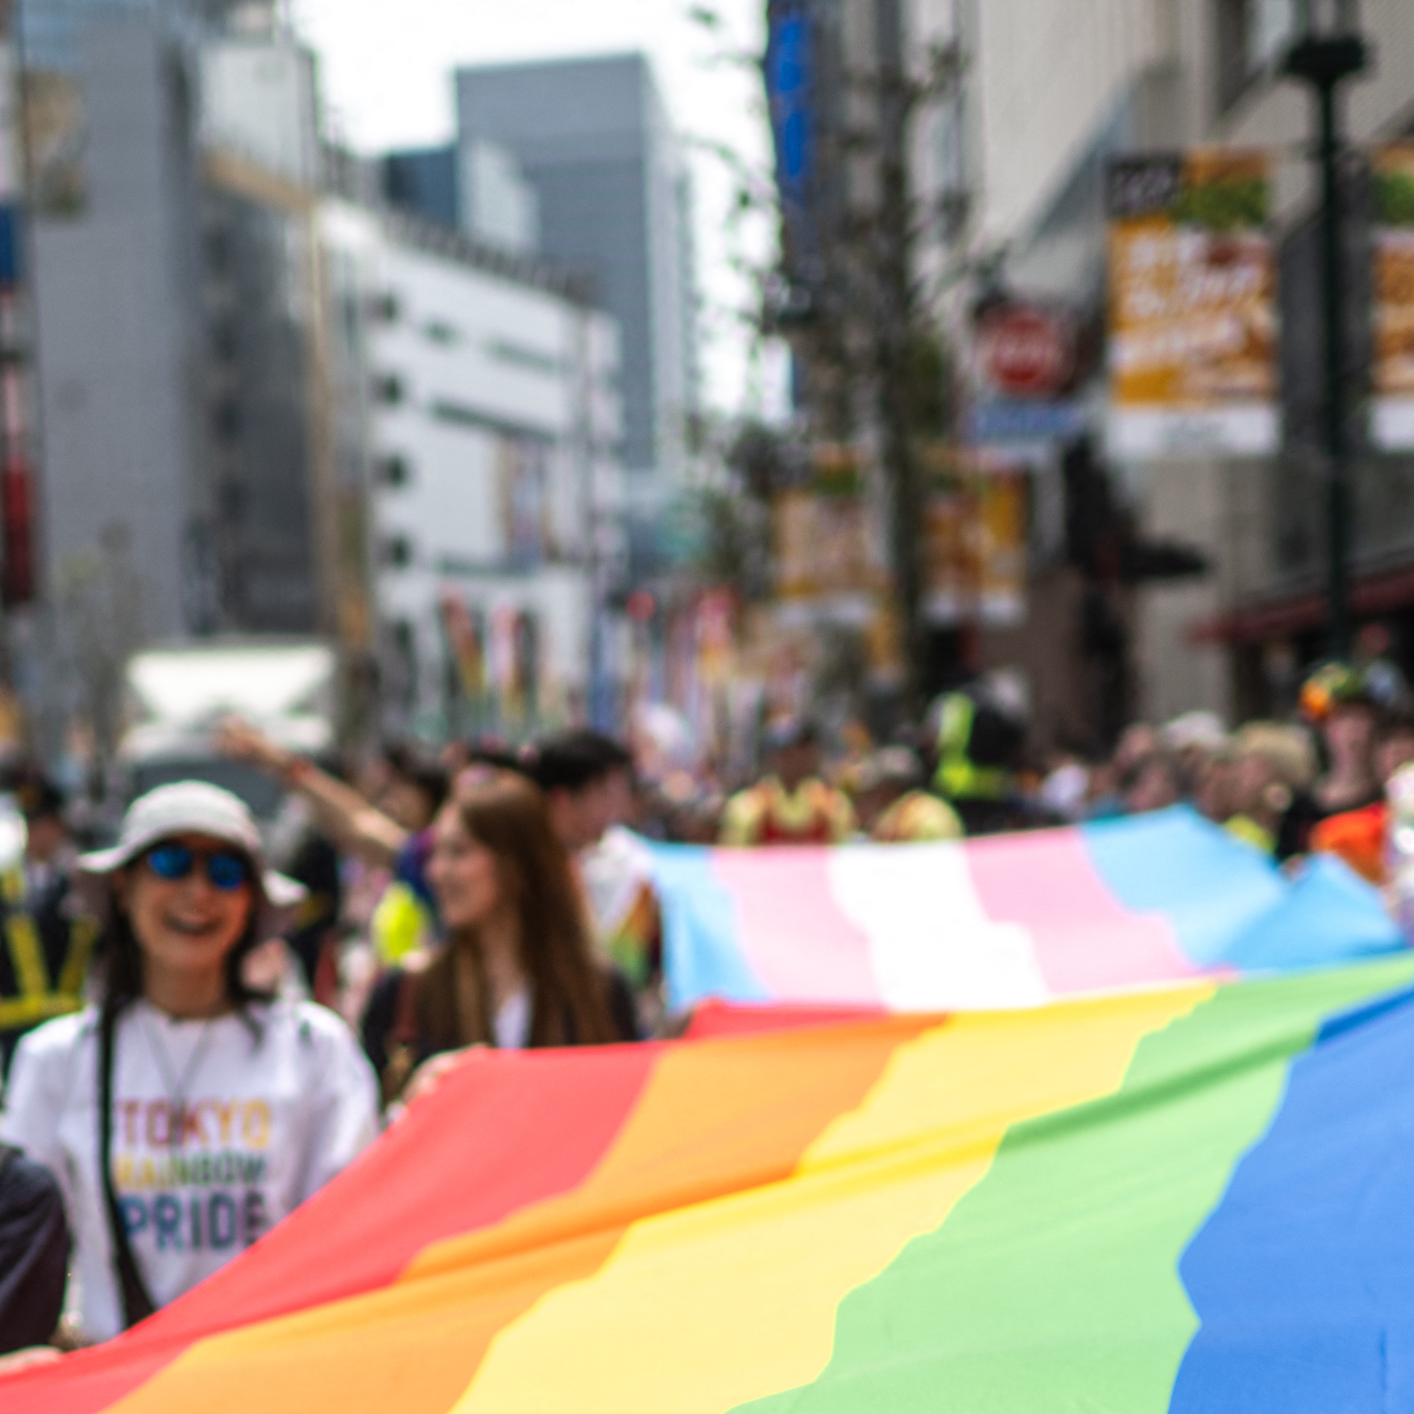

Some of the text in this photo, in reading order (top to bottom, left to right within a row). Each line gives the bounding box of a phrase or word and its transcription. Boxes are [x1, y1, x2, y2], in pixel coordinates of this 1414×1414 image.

[120, 1099, 271, 1149] TOKYO
[116, 1152, 267, 1189] RAINBOW
[118, 1192, 266, 1251] PRIDE
